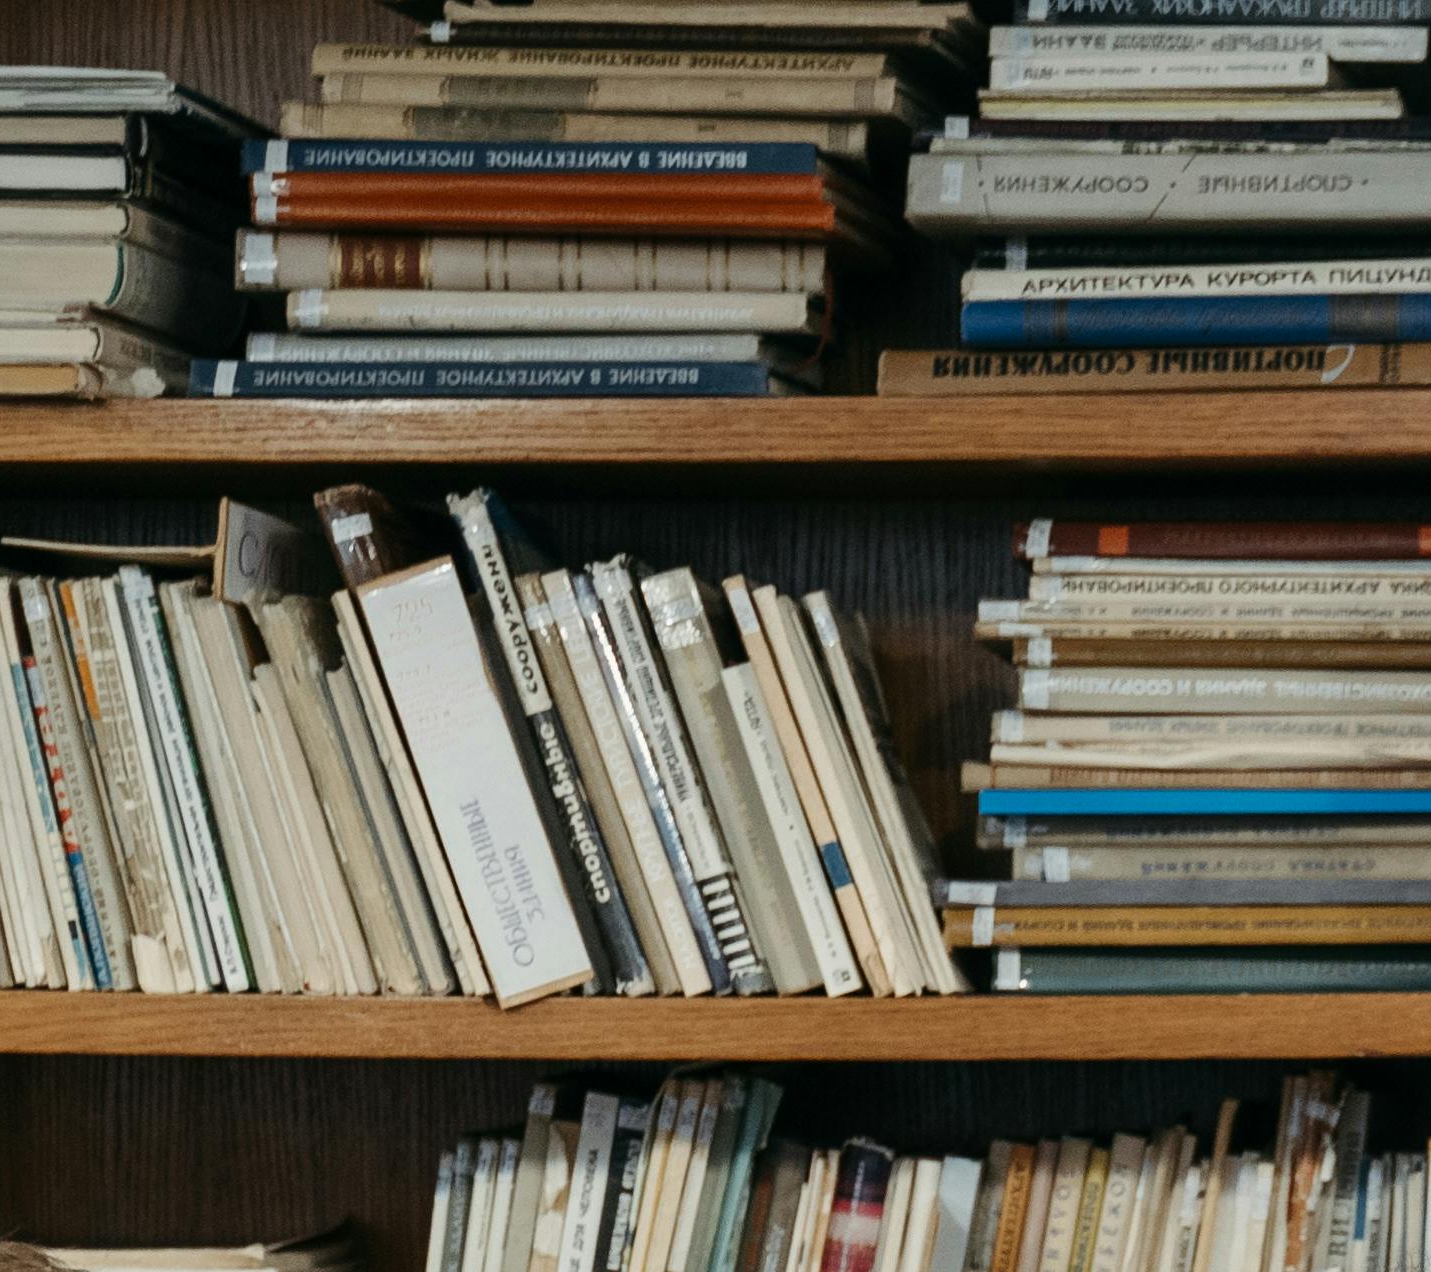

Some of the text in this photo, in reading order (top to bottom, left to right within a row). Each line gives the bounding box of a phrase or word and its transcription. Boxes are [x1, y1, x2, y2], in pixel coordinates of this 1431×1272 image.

[304, 149, 474, 168] ПРОЕКТИРОВАНИЕ
[485, 149, 632, 169] АРХИТЕКТУРНОЕ
[658, 149, 747, 169] ВВЕДЕНИЕ
[992, 173, 1352, 194] СПОРТИВНЫЕ СООРУЖЕНИЯ
[1021, 272, 1194, 294] АРХИТЕКТУРА
[1207, 268, 1316, 288] КУРОРТА
[932, 350, 1135, 379] СООРУЖЕНИЯ
[253, 368, 424, 386] ПРОЕКТИРОВАНИЕ
[435, 367, 583, 386] АРХИТЕКТУРНОЕ
[609, 367, 698, 384] ВВЕДЕНИЕ
[1218, 578, 1379, 595] АРХИТЕКТУРНОГО
[532, 717, 614, 907] спортивные
[456, 793, 538, 971] ОБЩЕСТВЕННЫЕ
